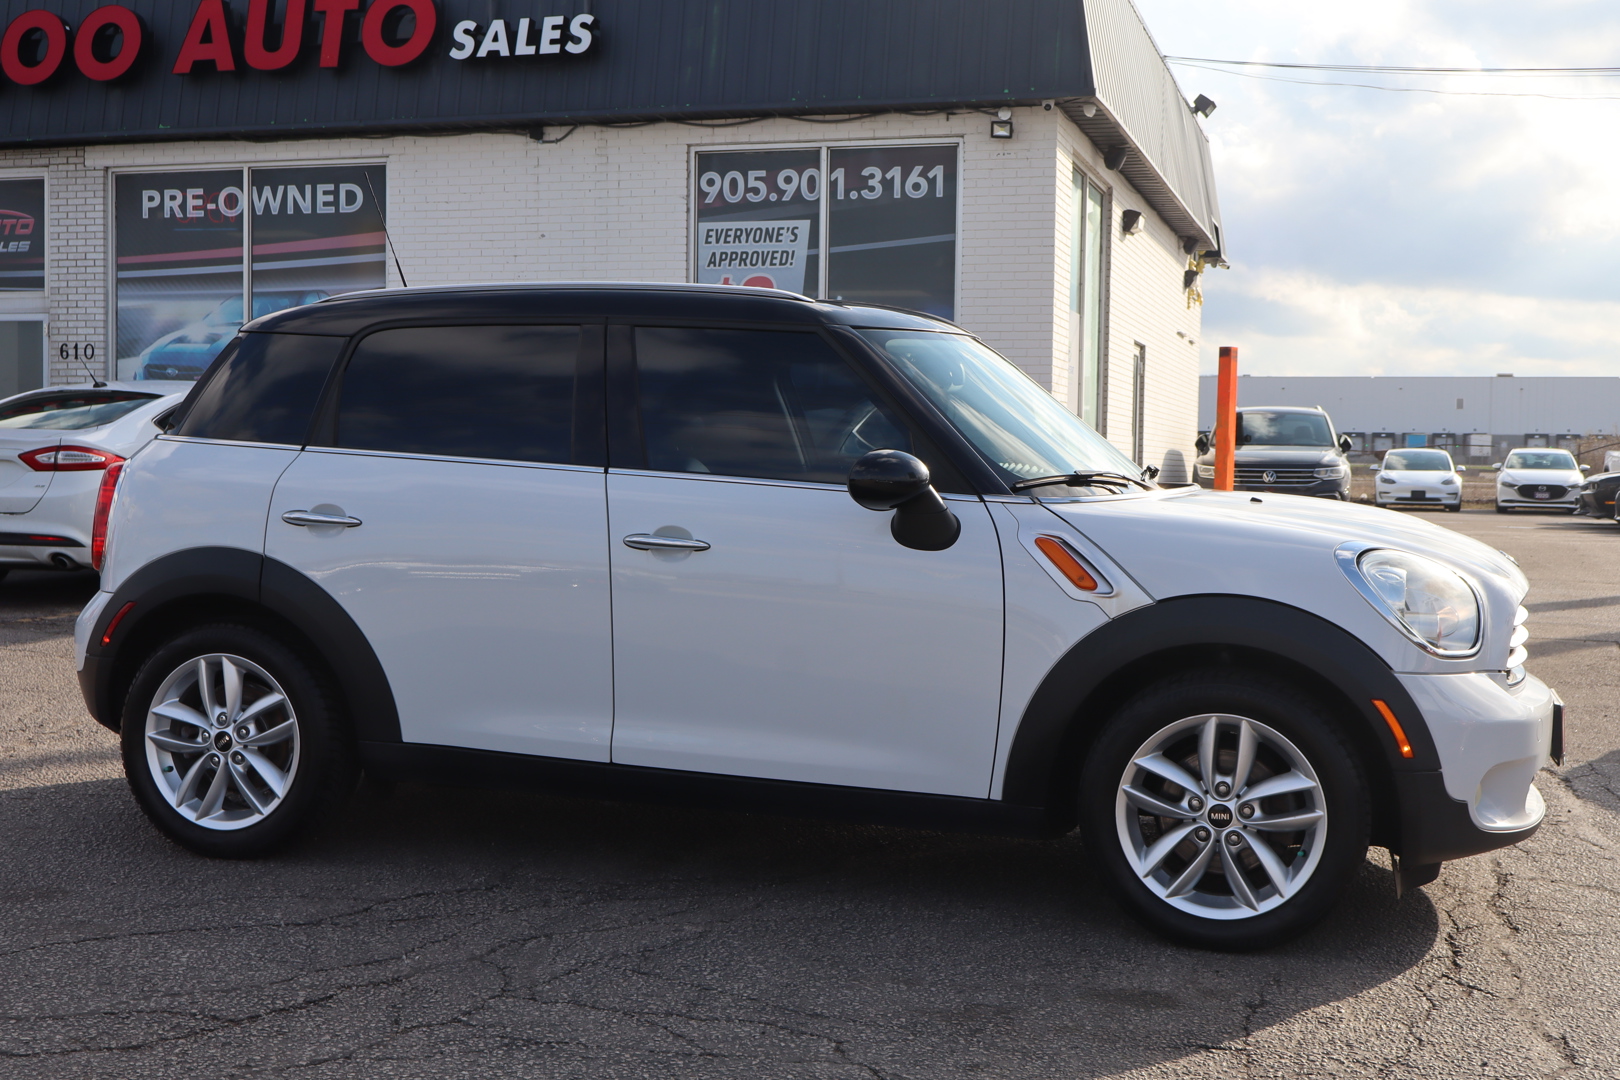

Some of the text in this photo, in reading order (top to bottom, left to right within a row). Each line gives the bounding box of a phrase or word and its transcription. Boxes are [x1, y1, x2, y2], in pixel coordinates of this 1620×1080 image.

[172, 0, 437, 74] AUTO
[449, 13, 595, 60] SALES
[700, 165, 944, 204] 905.901.3161
[142, 183, 364, 219] PRE-OWNED
[704, 226, 799, 244] EVERYONE'S
[706, 250, 795, 267] APPROVED!
[60, 343, 95, 360] 610
